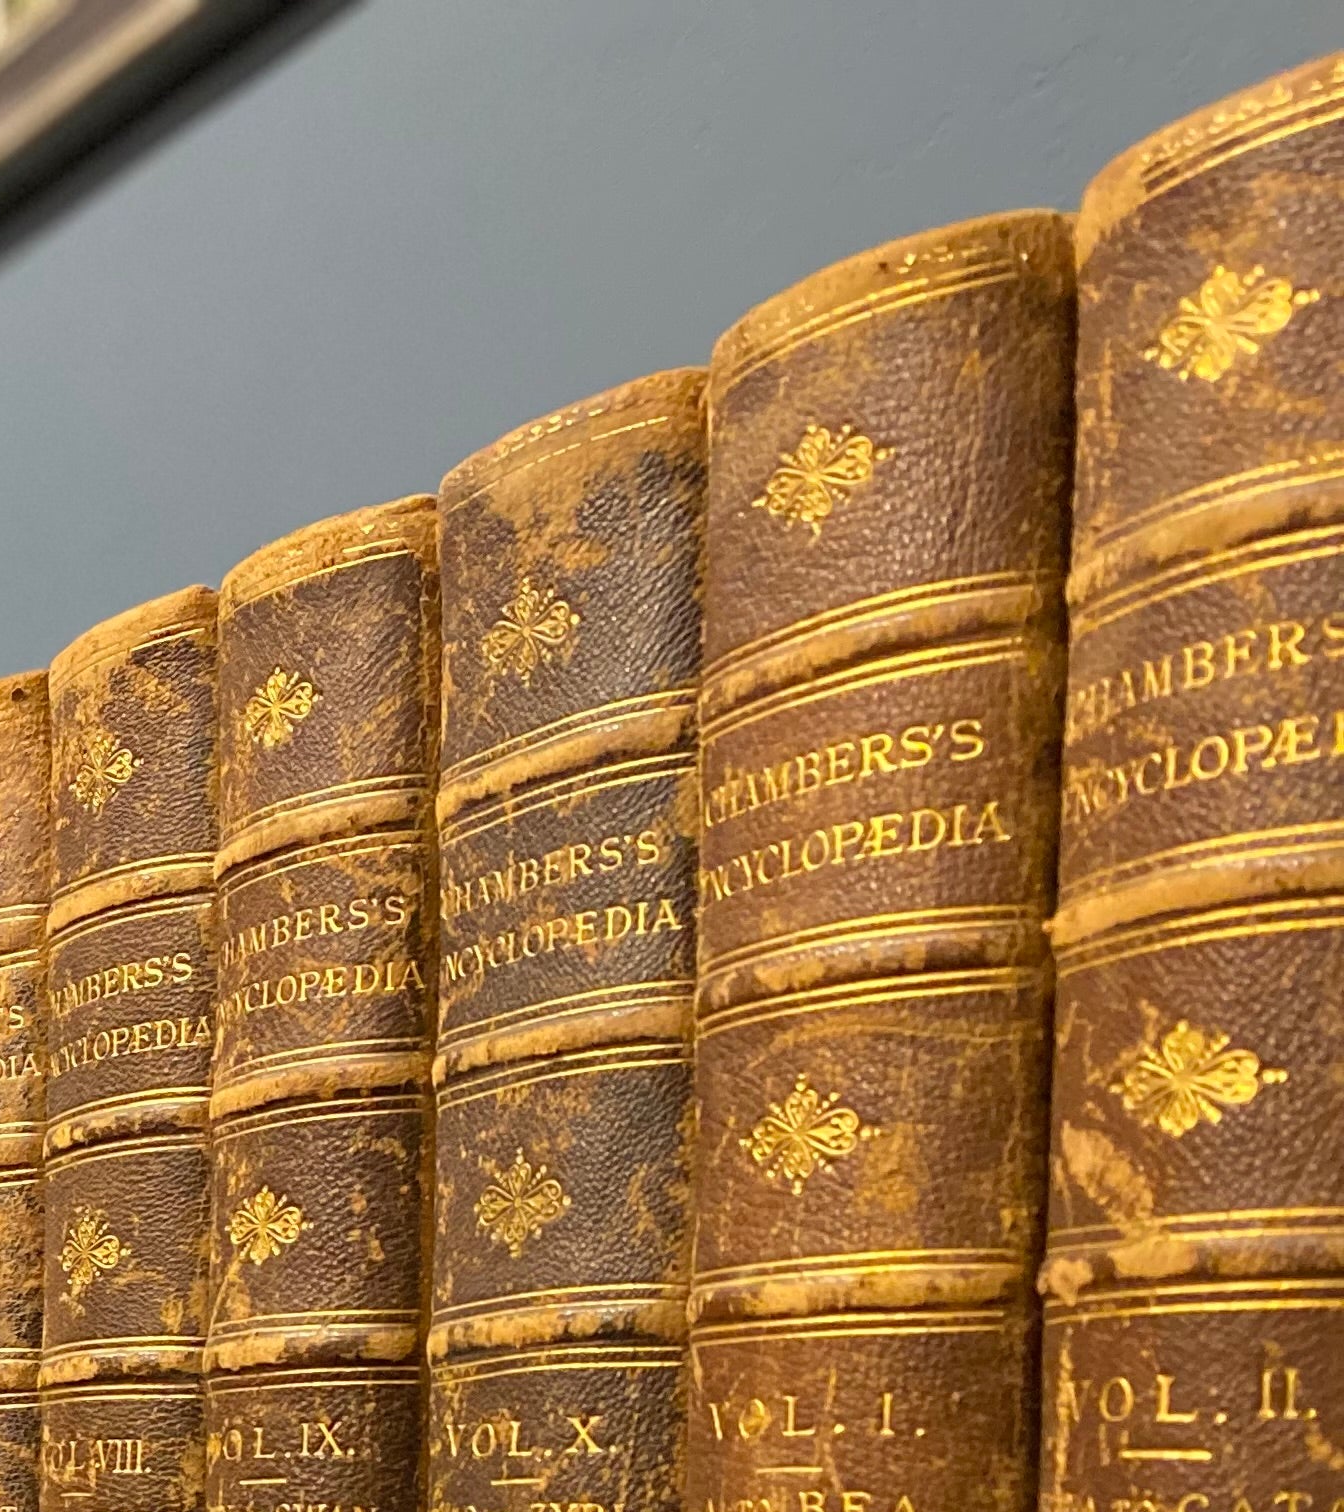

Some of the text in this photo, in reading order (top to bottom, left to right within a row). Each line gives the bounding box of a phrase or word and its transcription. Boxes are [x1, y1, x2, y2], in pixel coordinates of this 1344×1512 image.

[880, 1392, 925, 1436] I.
[96, 1439, 152, 1474] VIII.
[300, 1422, 355, 1460] IX.
[447, 1415, 616, 1458] VOL. X.
